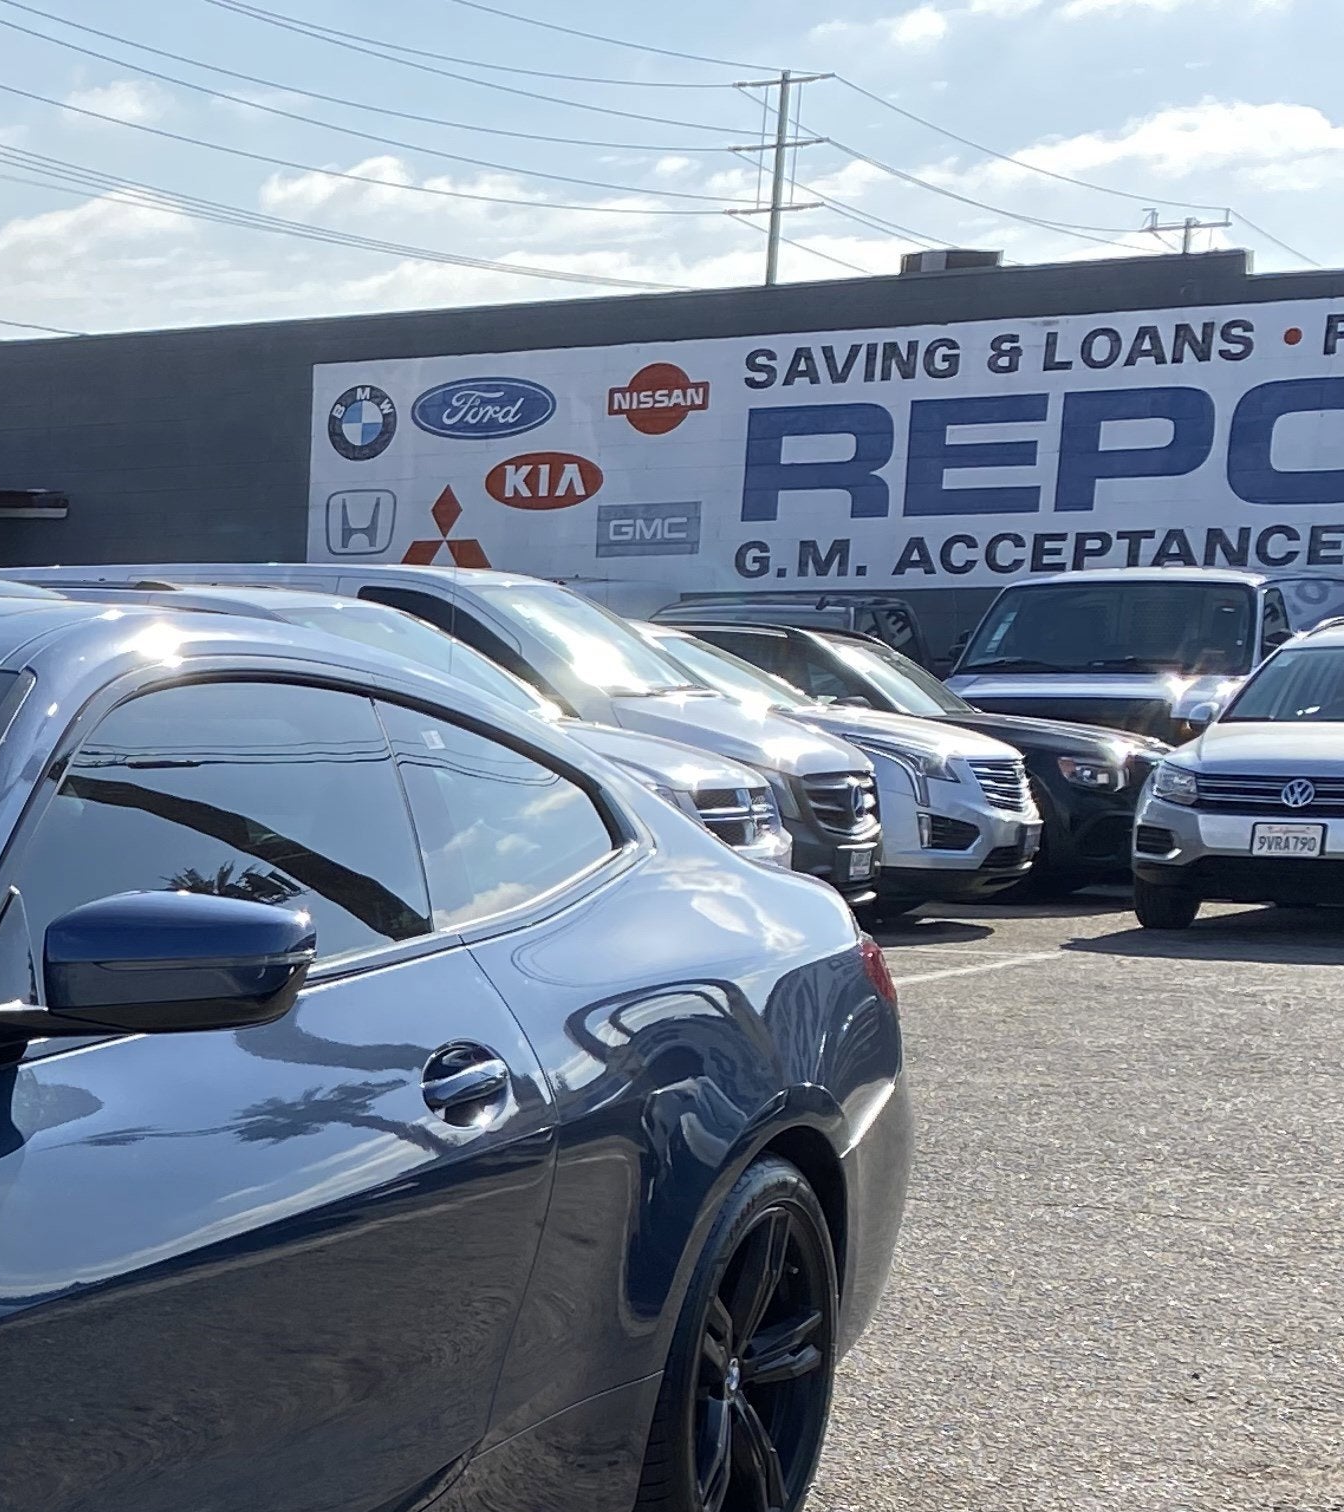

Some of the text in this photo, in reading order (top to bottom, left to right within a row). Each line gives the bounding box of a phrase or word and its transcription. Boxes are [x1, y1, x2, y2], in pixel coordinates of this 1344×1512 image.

[744, 318, 1255, 390] SAVING & LOANS
[442, 390, 525, 425] Ford
[613, 387, 705, 411] NISSAN
[504, 463, 586, 498] KIA
[609, 517, 688, 541] GMC
[734, 524, 1344, 579] G.M. ACCEPTANCE
[1257, 835, 1317, 852] 9VRA790
